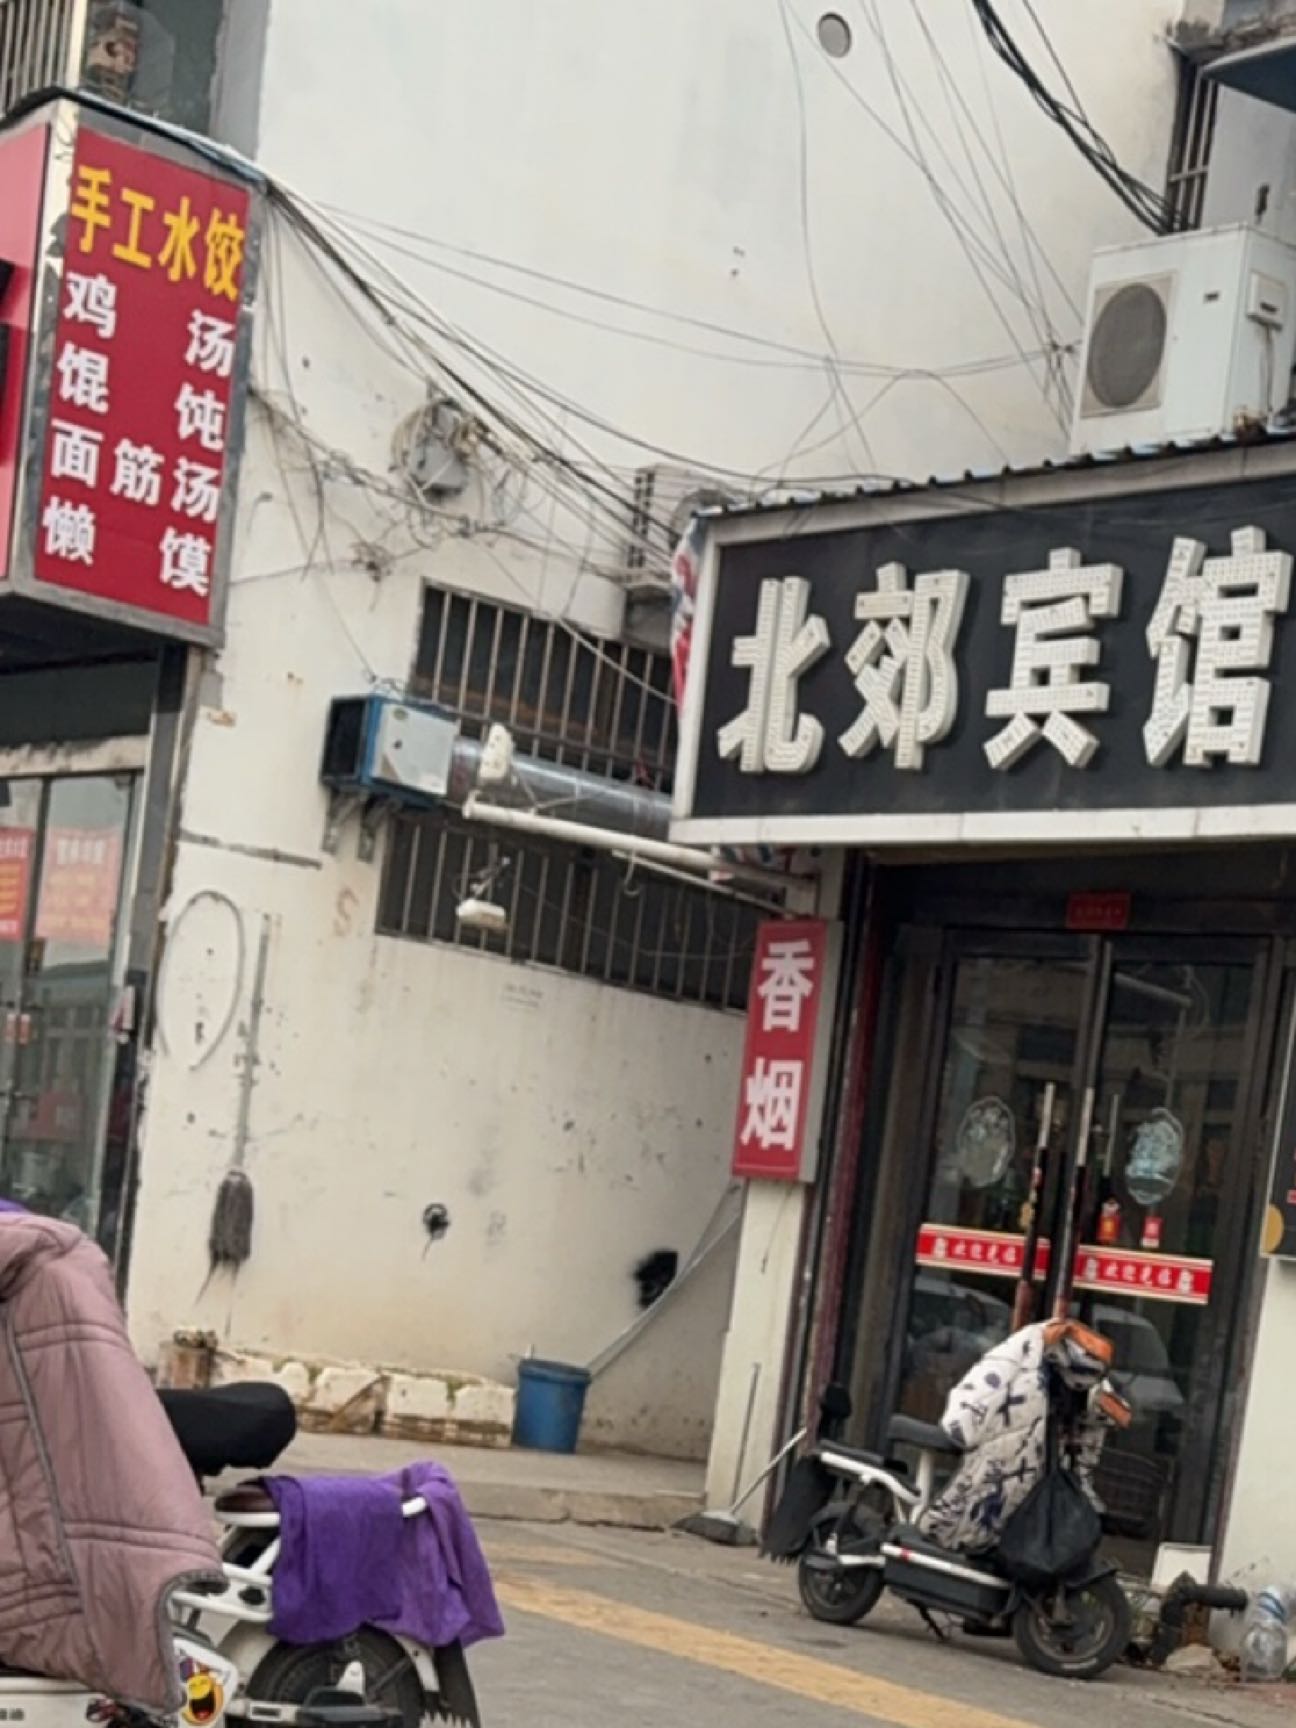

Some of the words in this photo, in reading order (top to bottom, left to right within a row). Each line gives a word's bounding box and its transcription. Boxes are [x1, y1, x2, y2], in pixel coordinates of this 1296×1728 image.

[70, 164, 245, 302] 手工水饺
[717, 525, 1294, 774] 北郊宾馆
[740, 937, 815, 1152] 香烟
